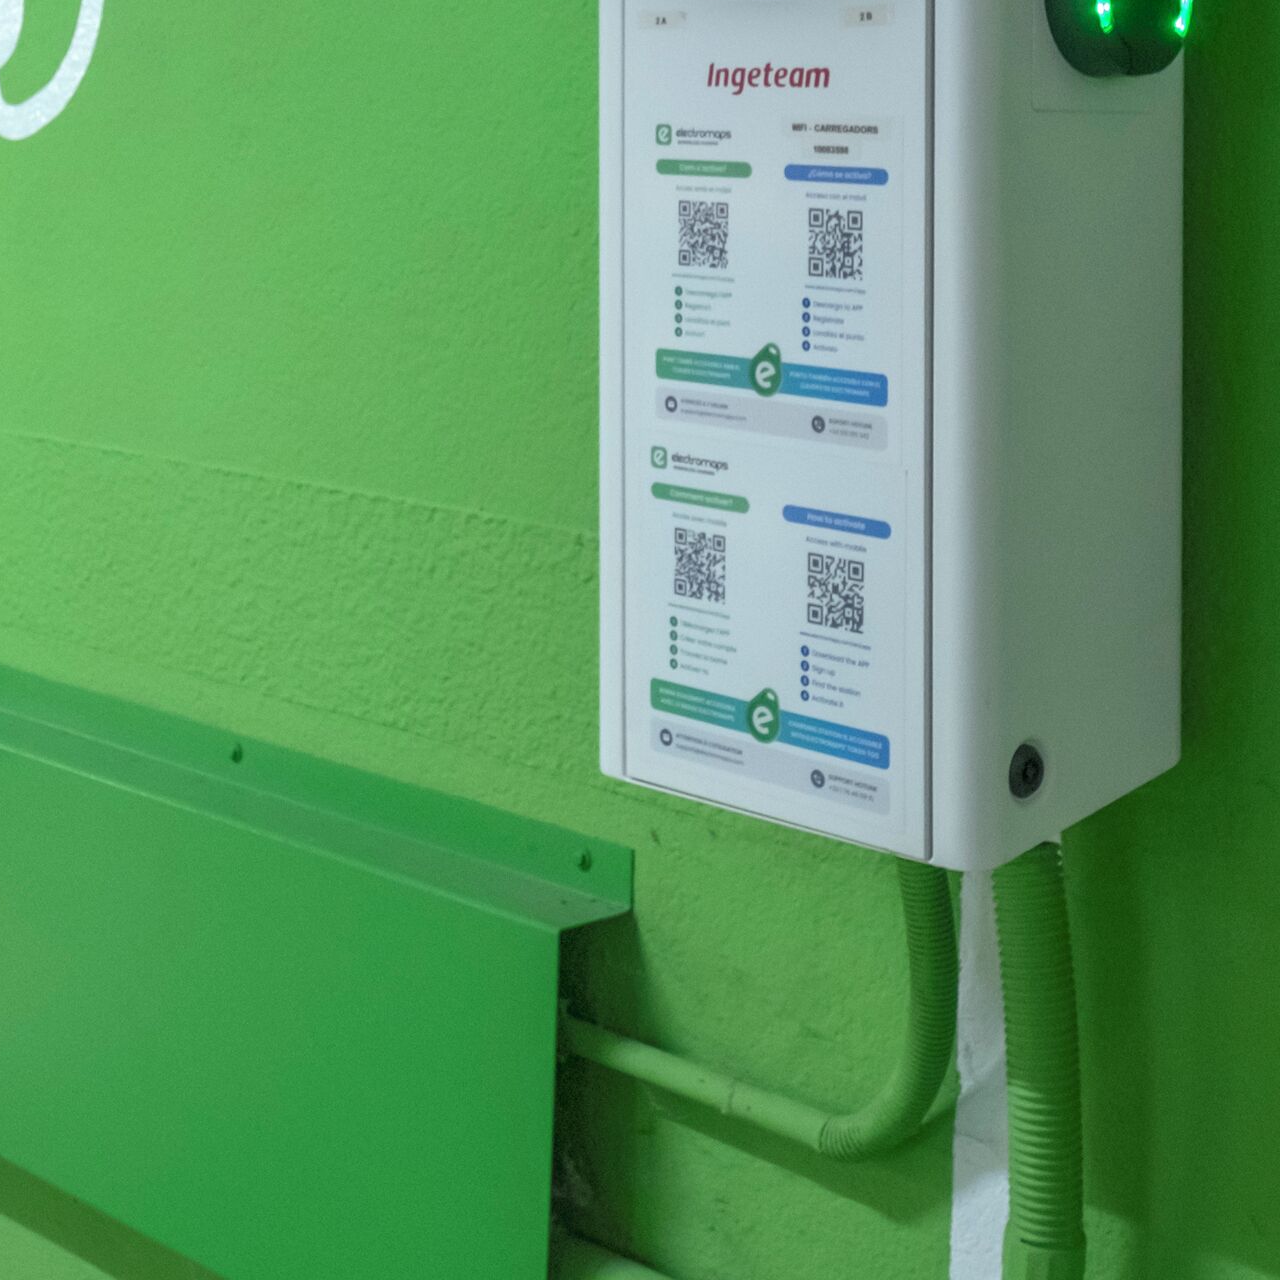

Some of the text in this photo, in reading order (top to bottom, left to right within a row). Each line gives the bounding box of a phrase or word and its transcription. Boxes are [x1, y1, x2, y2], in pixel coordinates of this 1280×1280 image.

[706, 61, 831, 95] Ingeteam
[675, 127, 732, 140] electromaps
[814, 123, 878, 135] CARREGADORS
[671, 451, 729, 471] electromaps
